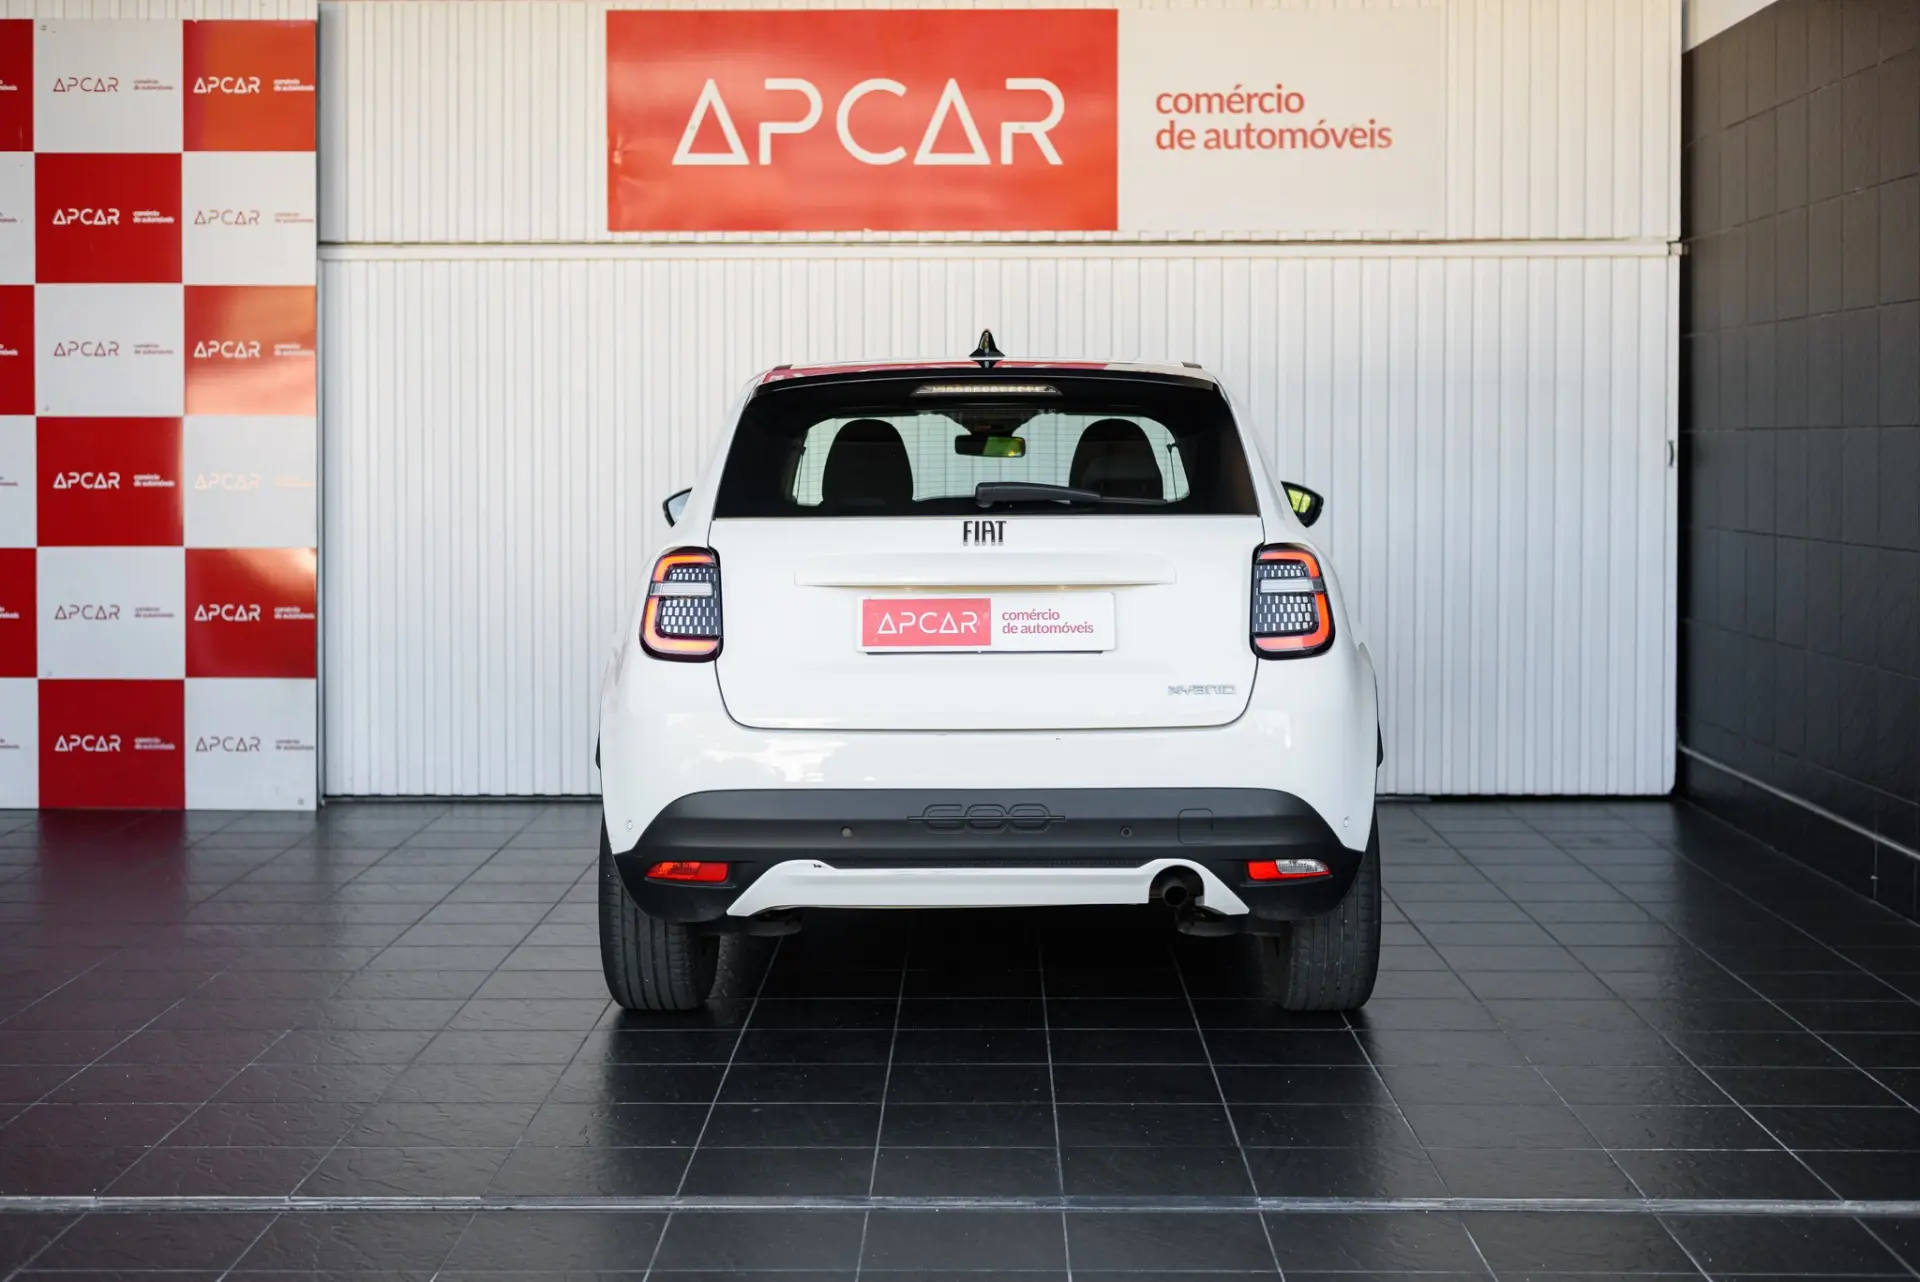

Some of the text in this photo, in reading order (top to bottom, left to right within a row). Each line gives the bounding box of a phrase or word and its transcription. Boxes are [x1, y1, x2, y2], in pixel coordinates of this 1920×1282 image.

[53, 77, 119, 93] APCAR
[193, 77, 261, 94] APCAR
[1156, 84, 1305, 115] comércio
[672, 78, 1065, 165] APCAR
[1156, 119, 1393, 150] de automóveis
[52, 208, 120, 226] APCAR
[194, 210, 260, 226] APCAR
[53, 341, 120, 357] APCAR
[193, 340, 261, 358] APCAR
[53, 472, 121, 489] APCAR
[963, 520, 1007, 544] FIAT
[54, 604, 121, 621] APCAR
[194, 604, 261, 621] APCAR
[1002, 608, 1060, 621] comércio
[876, 611, 979, 635] APCAR
[1002, 622, 1094, 634] de automóveis
[55, 735, 121, 753] APCAR
[196, 736, 261, 753] APCAR
